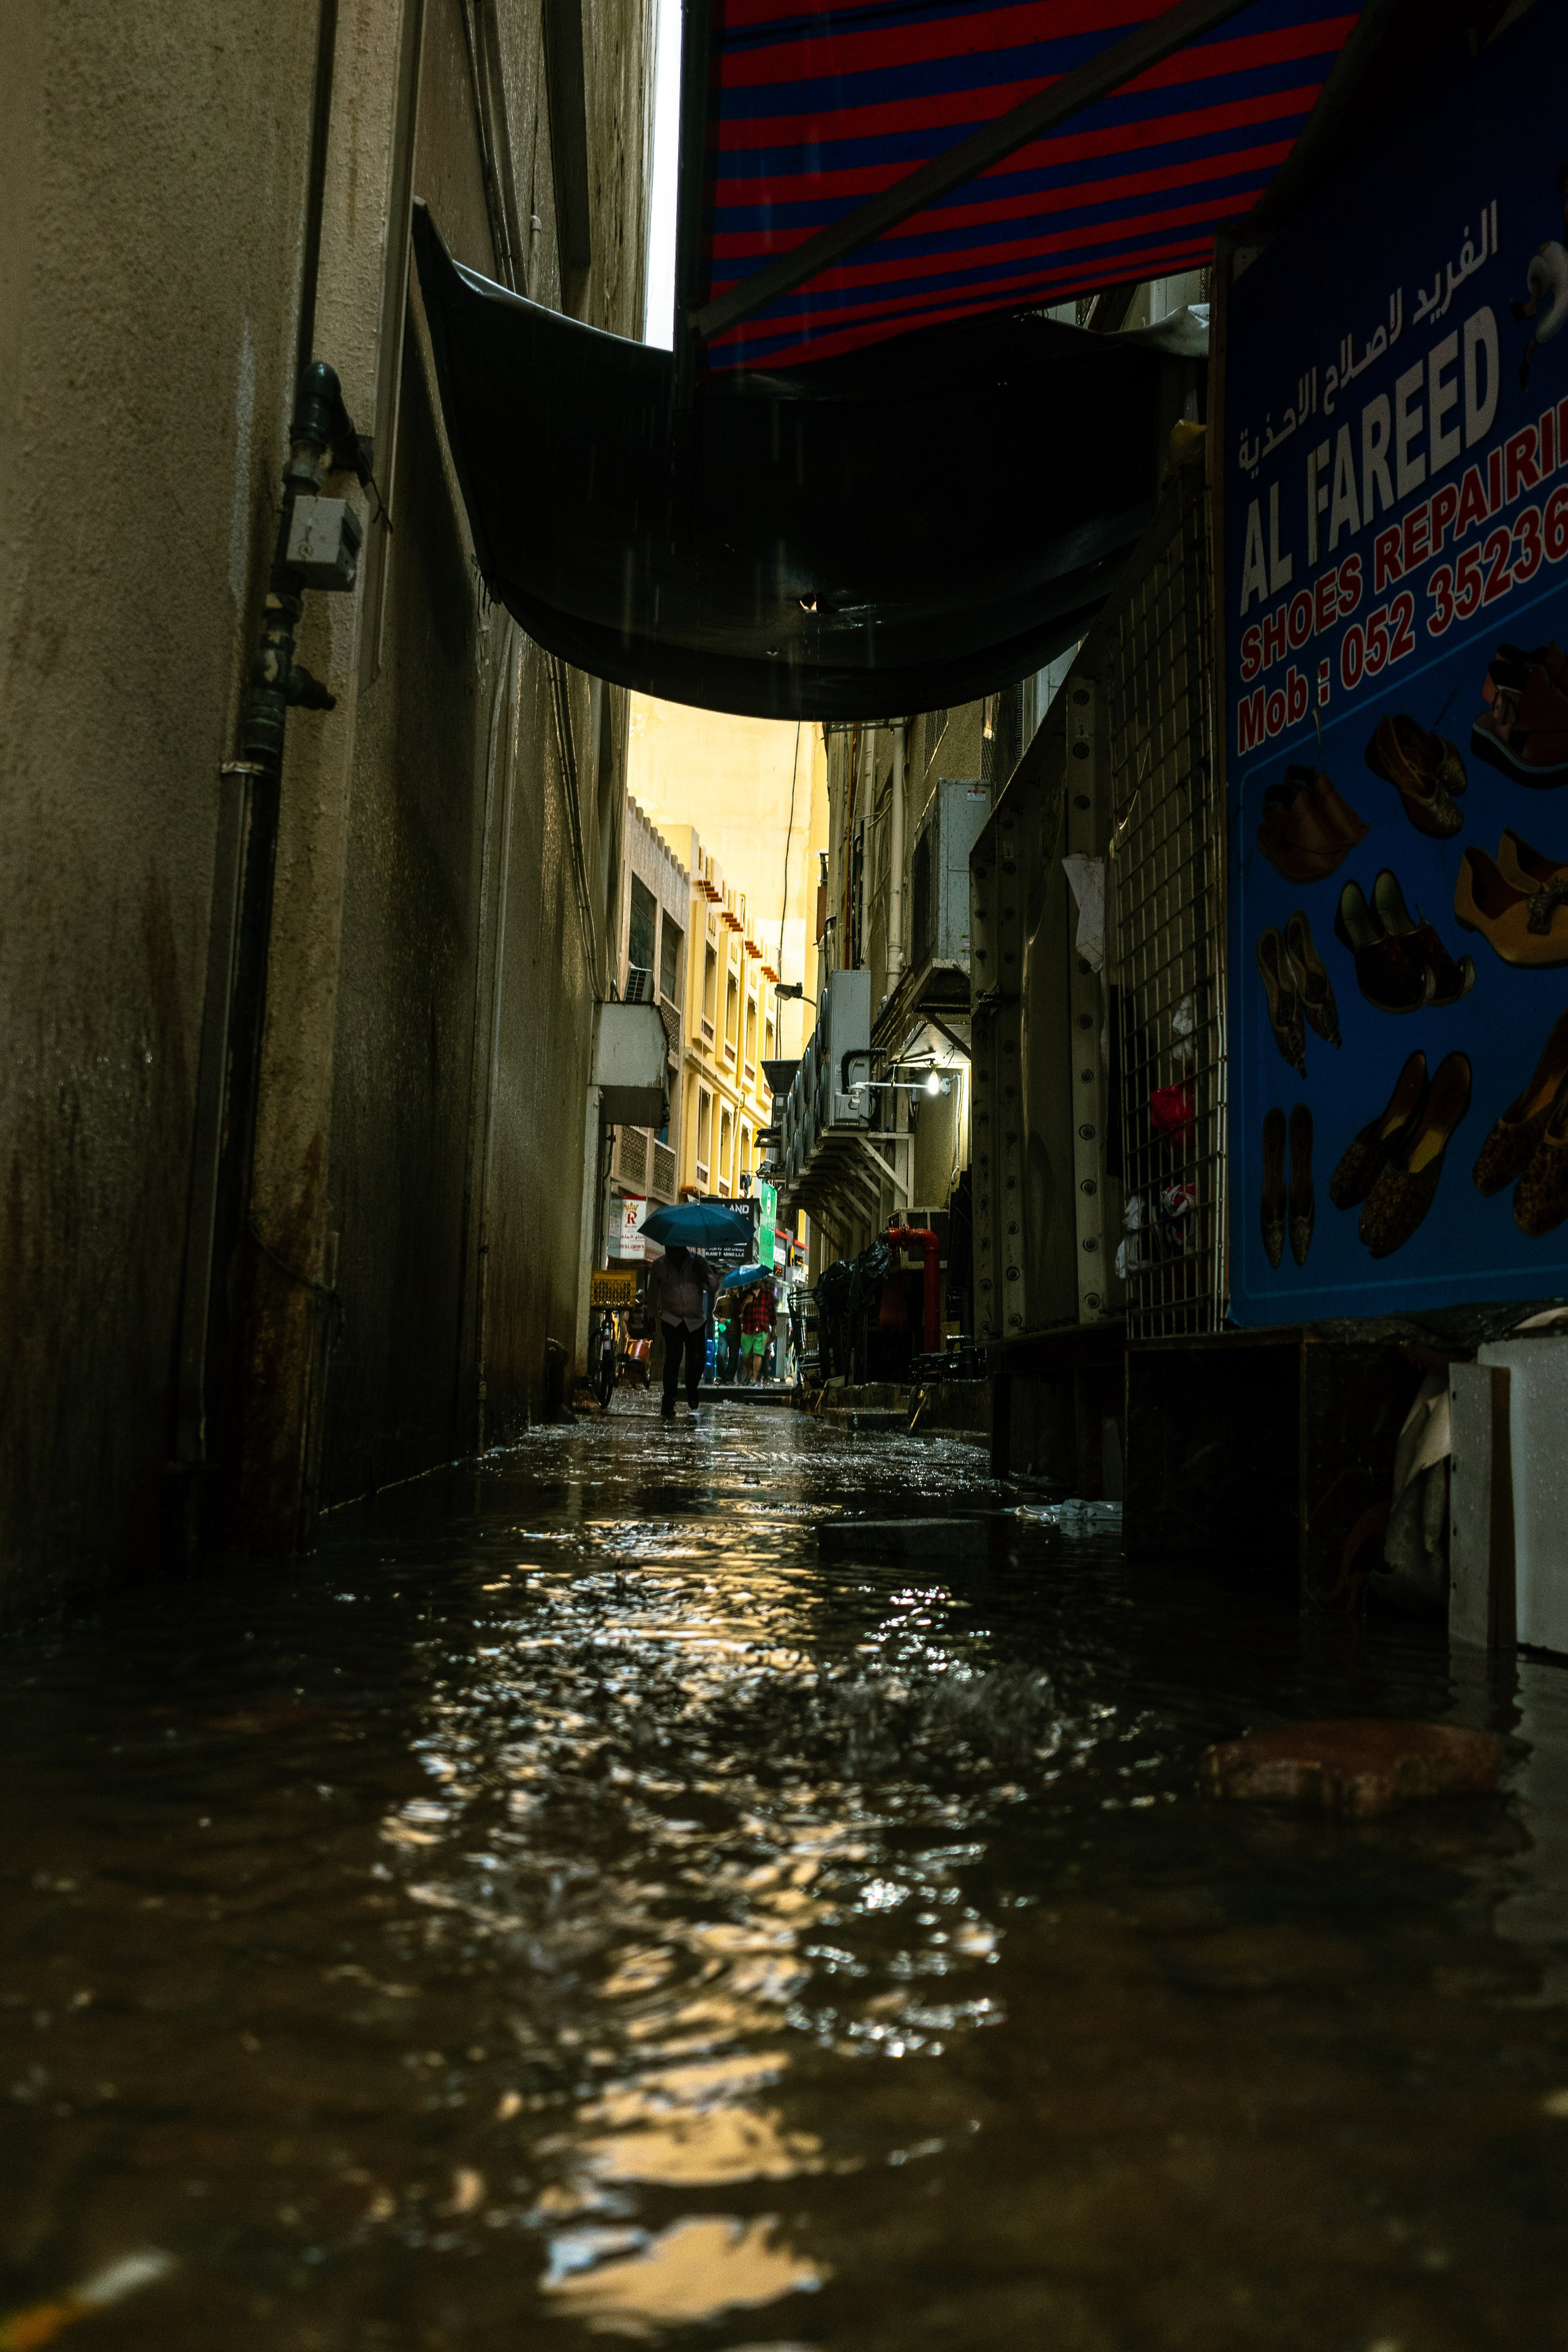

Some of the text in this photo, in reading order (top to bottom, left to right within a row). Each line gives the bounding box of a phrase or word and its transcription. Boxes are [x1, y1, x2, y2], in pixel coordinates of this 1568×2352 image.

[1238, 198, 1499, 480] الفريد لاصلاح الاحذية
[1239, 305, 1501, 617] AL FAREED
[1239, 552, 1363, 684] SHOES
[1340, 589, 1415, 692] 052
